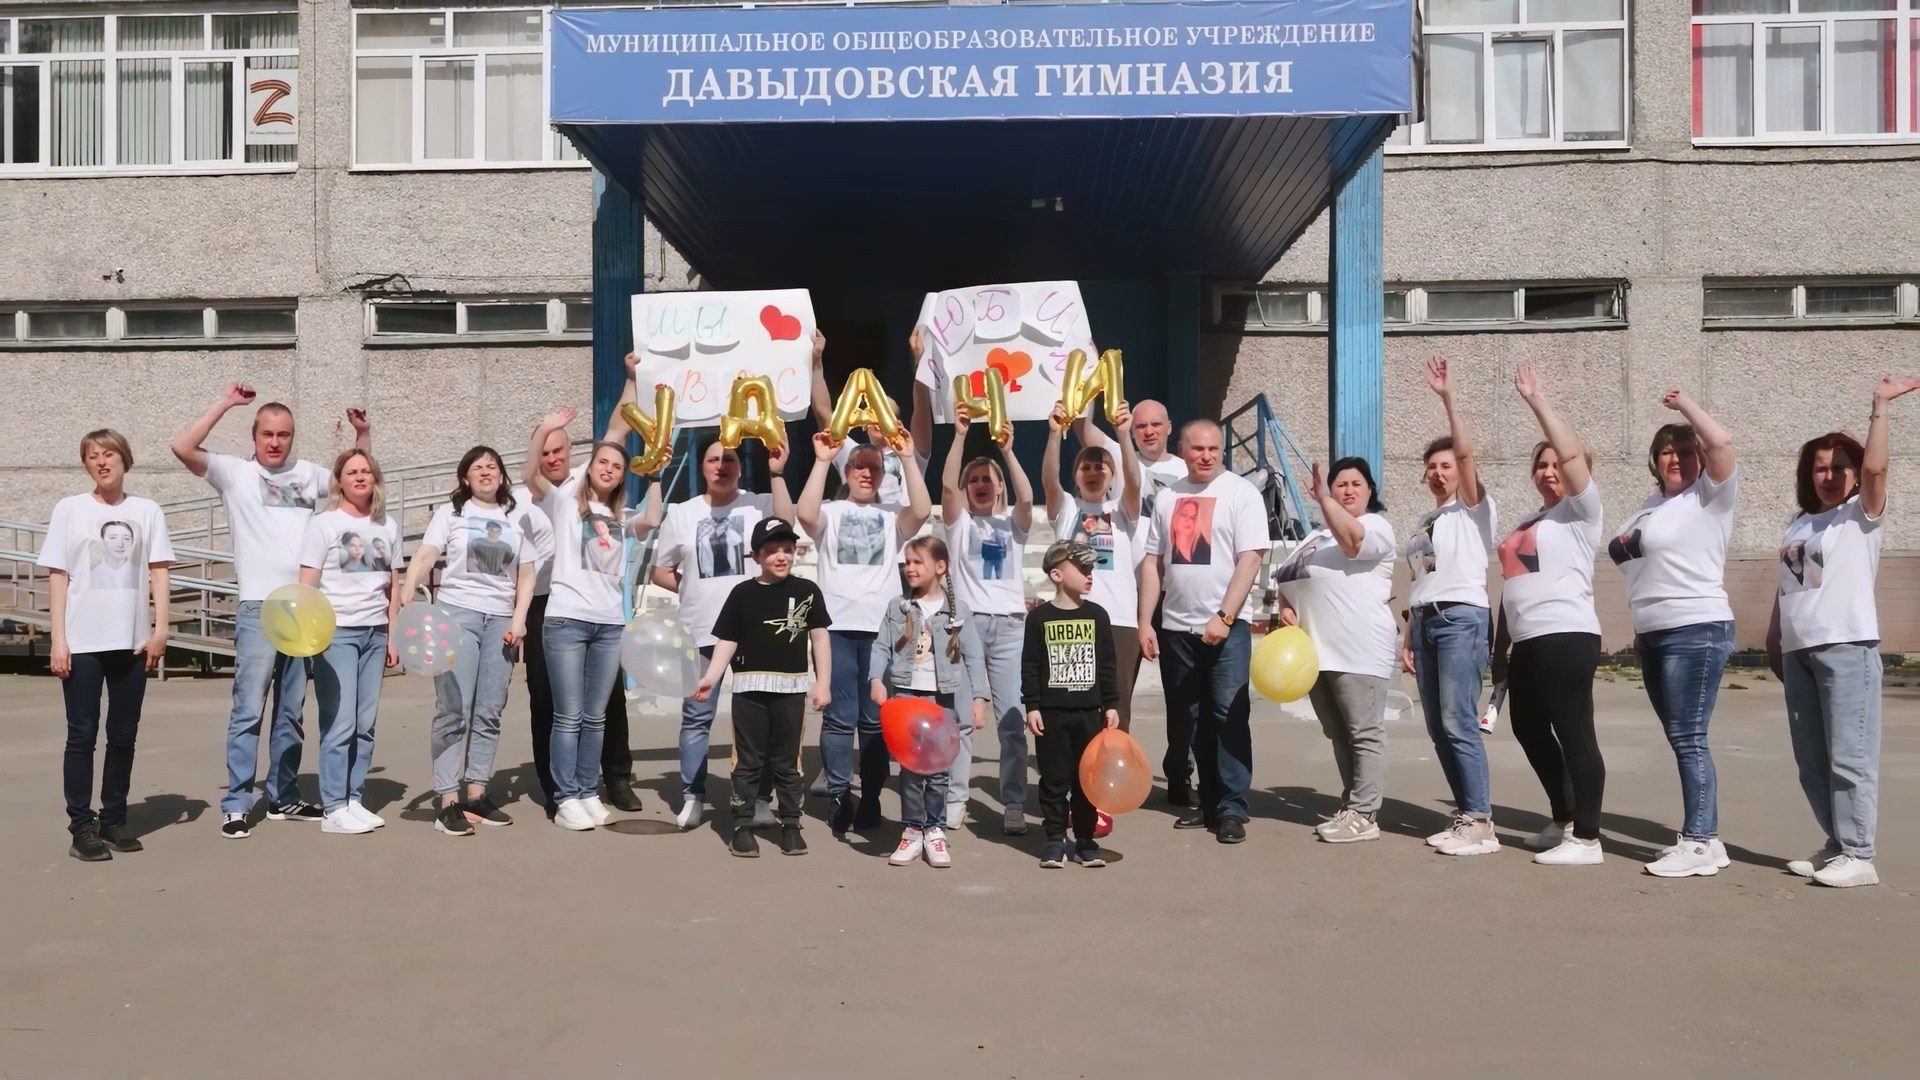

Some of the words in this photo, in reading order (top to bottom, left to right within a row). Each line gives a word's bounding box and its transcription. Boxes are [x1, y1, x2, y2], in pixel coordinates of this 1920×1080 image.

[585, 32, 825, 56] МУНИЦИПАЛЬНОЕ
[832, 26, 1178, 54] ОБЩЕОБРАЗОВАТЕЛЬНОЕ
[1186, 22, 1376, 47] УЧРЕЖДЕНИЕ
[662, 64, 1018, 108] ДАВЫДОВСКАЯ
[1034, 61, 1293, 97] ГИМНАЗИЯ
[250, 79, 295, 126] Z
[677, 367, 799, 405] ВС
[1048, 624, 1092, 641] URBAN
[1051, 643, 1093, 664] SKATE
[1051, 663, 1093, 682] BOARD
